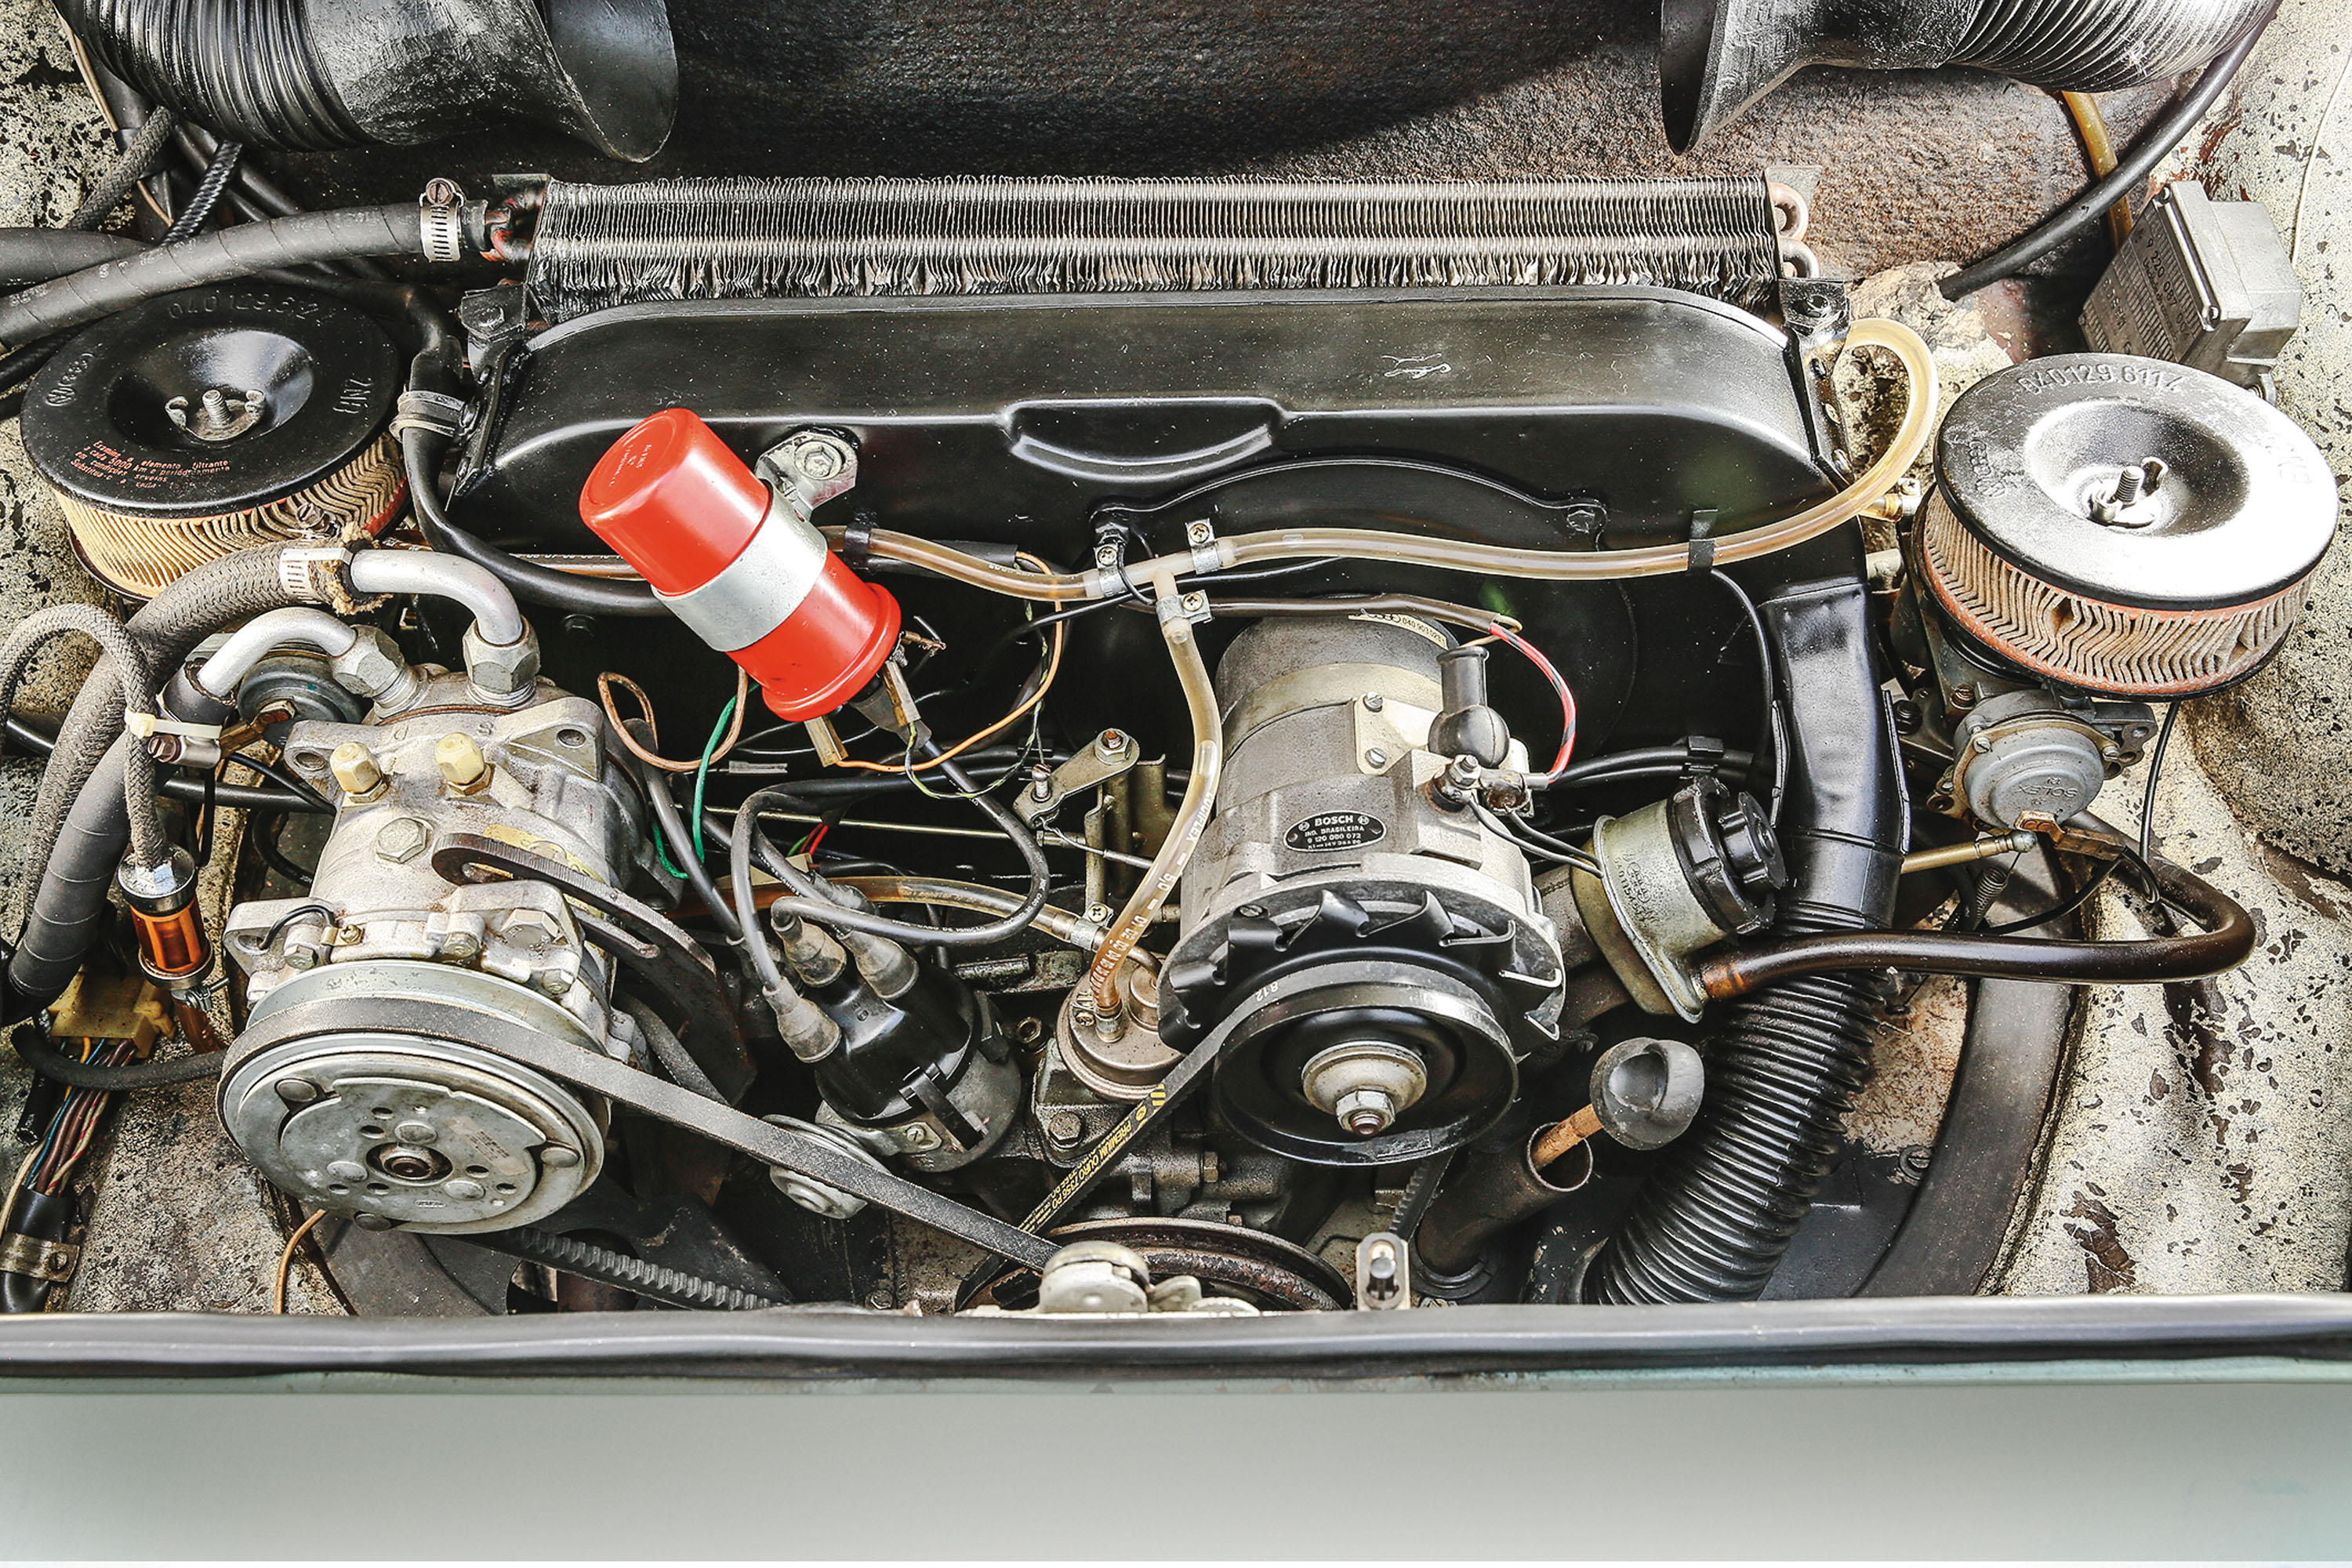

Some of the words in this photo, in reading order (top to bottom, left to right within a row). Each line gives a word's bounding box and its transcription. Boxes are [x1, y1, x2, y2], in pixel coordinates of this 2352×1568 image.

[2151, 251, 2165, 278] 220
[2163, 281, 2178, 306] 087
[108, 457, 132, 470] 5000
[133, 465, 147, 474] km
[140, 459, 181, 470] elemento
[2016, 785, 2078, 798] SOLEX
[1185, 793, 1214, 844] LUCIFLEX
[1315, 815, 1353, 826] BOSCH
[1321, 826, 1364, 834] BRASILEIRA
[1157, 873, 1176, 892] 5,0
[1255, 982, 1279, 1002] 812
[1099, 1120, 1132, 1159] PREMIUM
[1079, 1154, 1099, 1180] OURO
